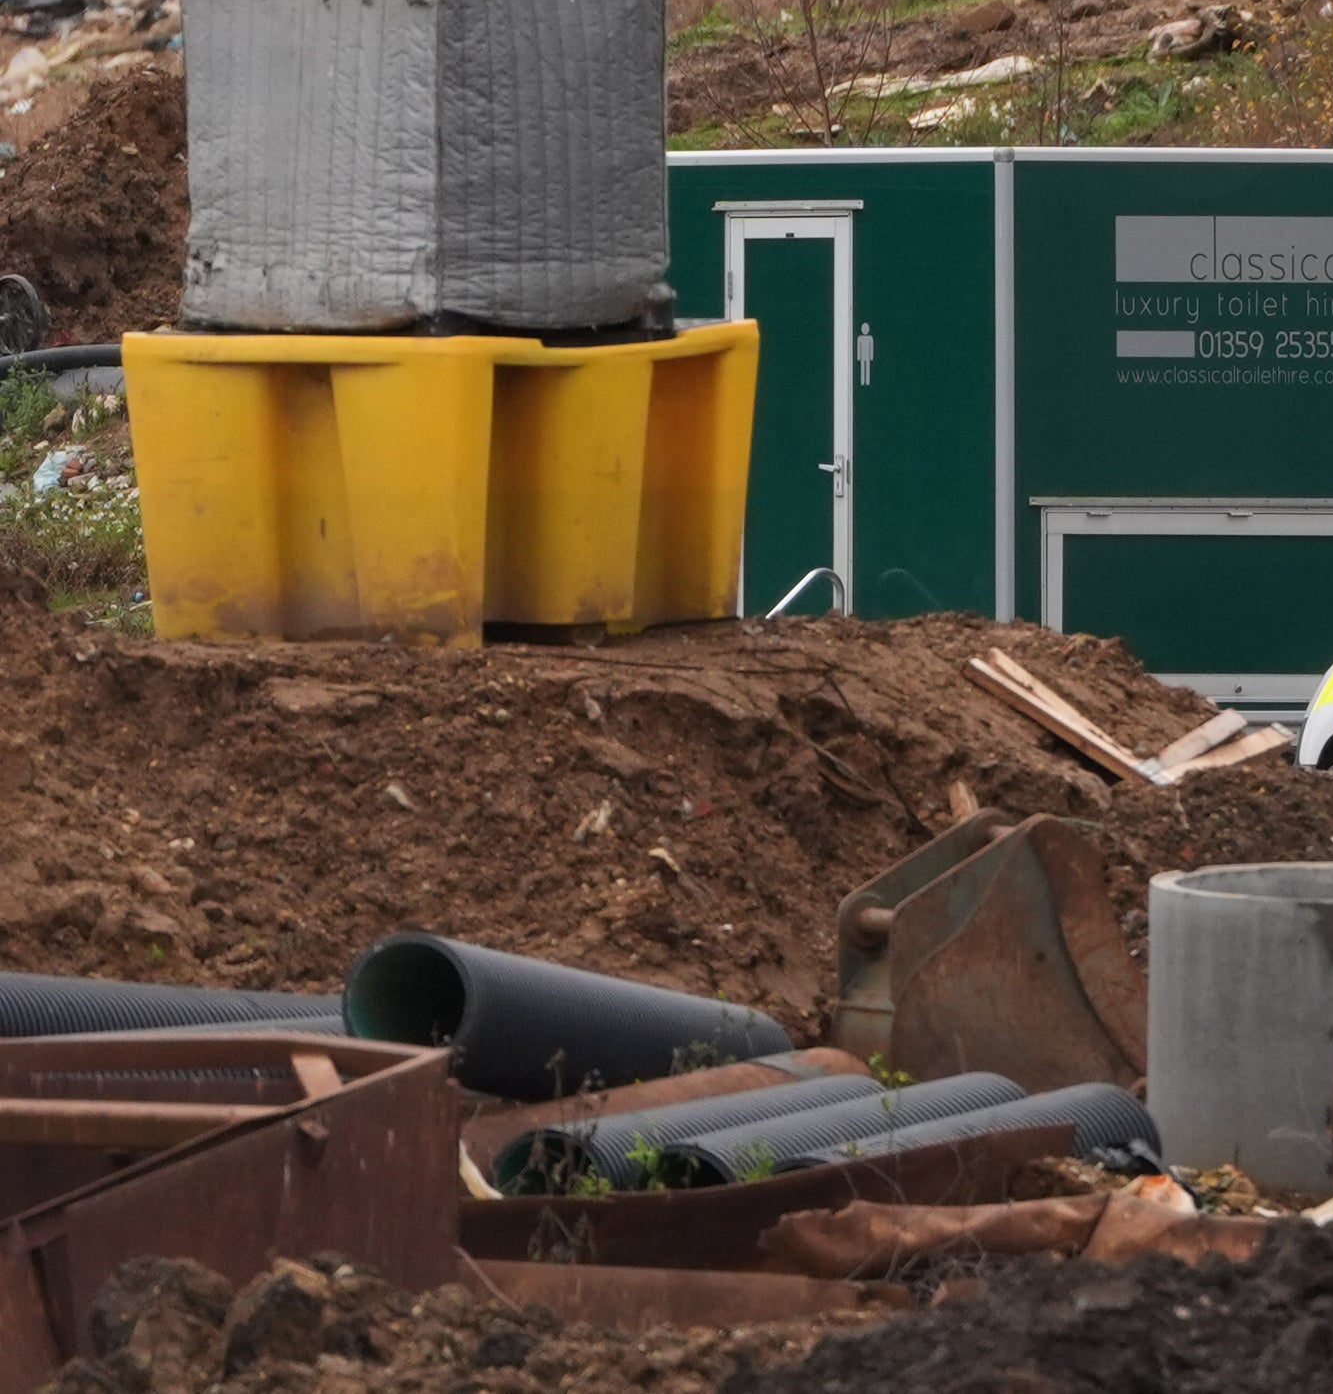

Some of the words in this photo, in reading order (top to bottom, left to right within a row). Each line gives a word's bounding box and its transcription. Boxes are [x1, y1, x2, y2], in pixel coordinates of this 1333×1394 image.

[1114, 289, 1200, 324] luxury
[1217, 289, 1289, 317] toilet
[1199, 331, 1265, 358] 01359
